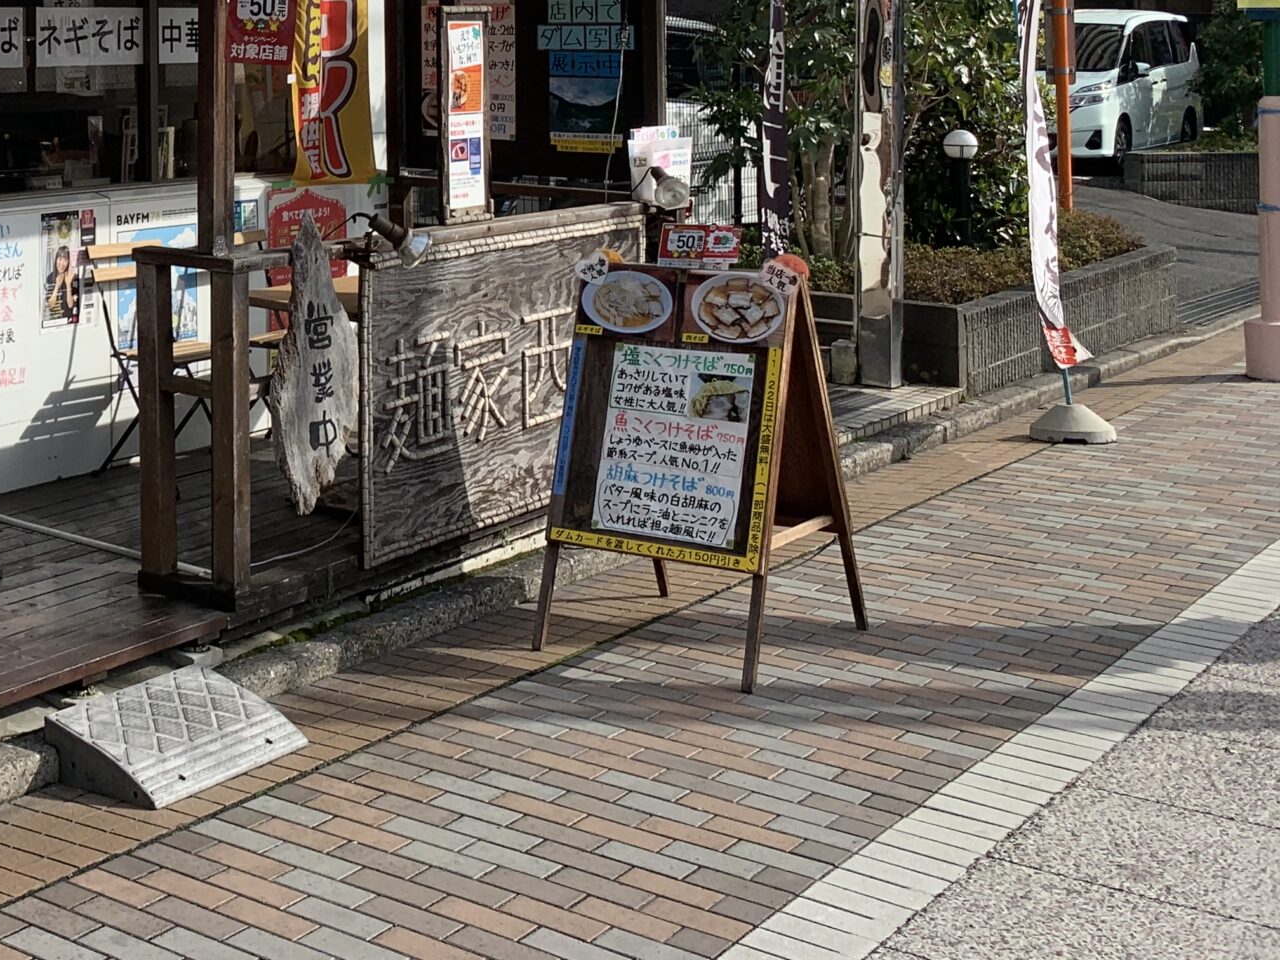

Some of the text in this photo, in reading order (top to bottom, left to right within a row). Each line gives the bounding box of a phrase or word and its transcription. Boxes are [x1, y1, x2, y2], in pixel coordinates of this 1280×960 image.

[550, 0, 621, 20] 店内で
[37, 17, 140, 56] ネギそば
[539, 26, 632, 49] ダム写真
[230, 42, 288, 61] 対象店舗
[551, 52, 621, 74] 展示中
[282, 206, 331, 222] 食べてしよう！
[580, 256, 608, 276] 女性一番
[589, 268, 607, 281] 人気
[766, 263, 799, 287] 当店一番
[765, 275, 787, 293] 人気
[621, 347, 753, 376] 塩こくつけそば 750円
[305, 300, 338, 457] 営業中
[617, 369, 689, 385] あっさりしていて
[613, 395, 686, 414] 女性に大人気！！
[613, 411, 746, 446] 魚こくつけそば 750円
[609, 433, 738, 463] しょうゆベースに魚粉が入った
[606, 464, 735, 499] 胡麻つけそば 800円
[603, 483, 722, 514] バター風味の白胡麻の
[602, 498, 729, 530] スープにラー油とニンニクを
